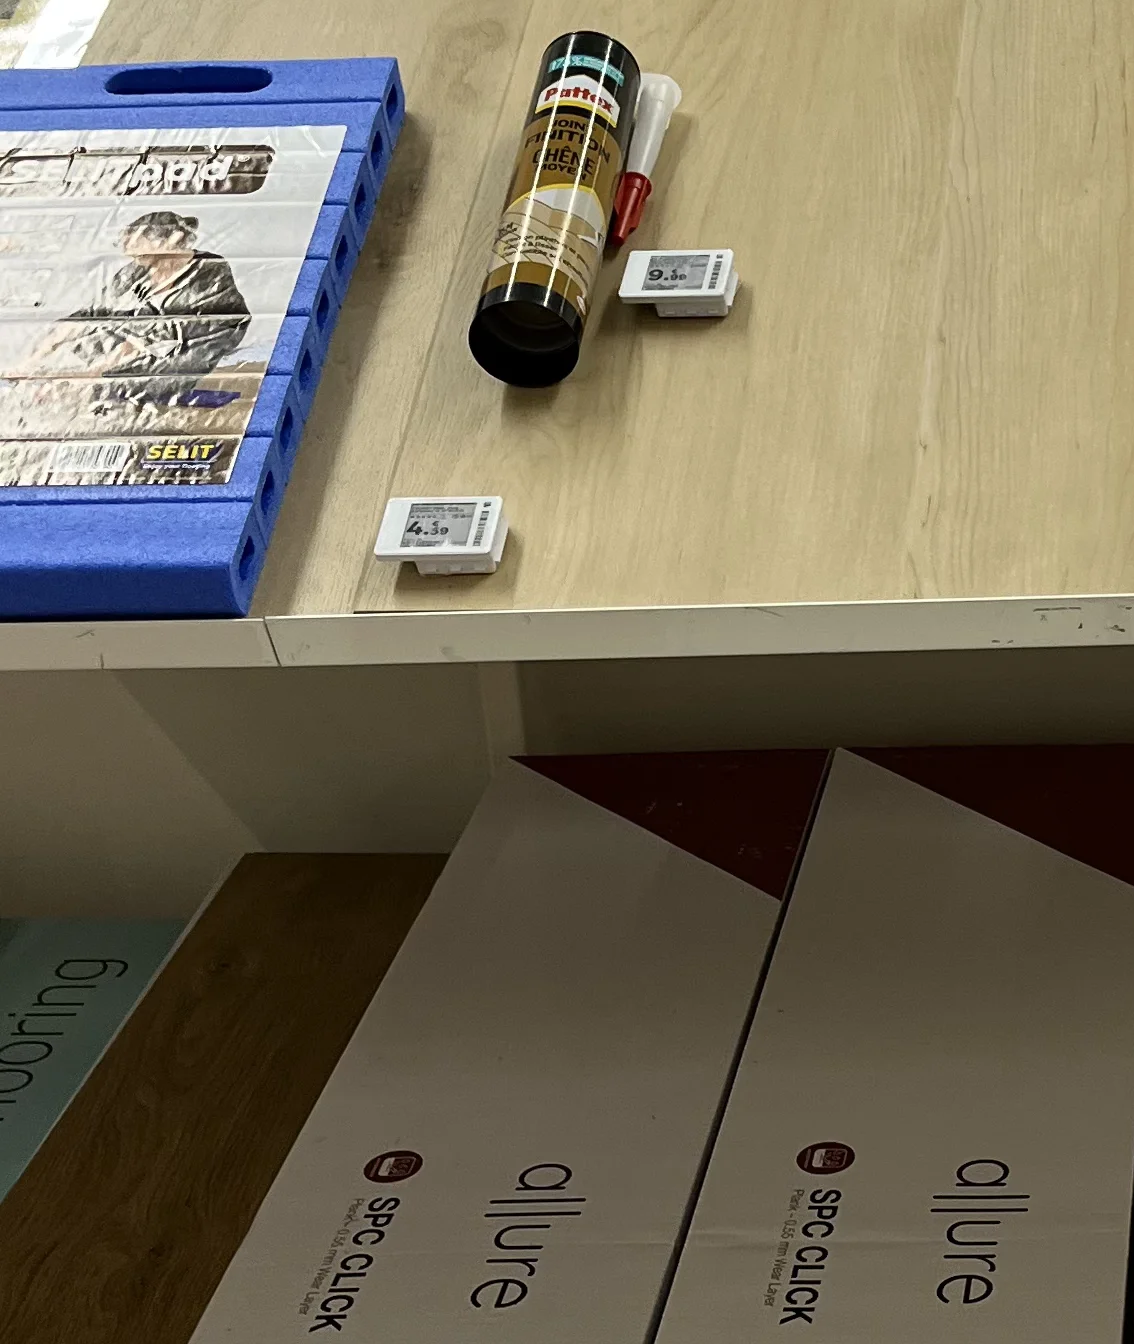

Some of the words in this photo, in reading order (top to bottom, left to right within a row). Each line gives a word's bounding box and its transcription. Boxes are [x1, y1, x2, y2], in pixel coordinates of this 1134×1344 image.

[544, 86, 614, 114] Pattex
[525, 130, 610, 164] FINITION
[552, 119, 594, 131] JOIN
[532, 146, 595, 176] CHÊNE
[147, 444, 215, 459] SELIT
[0, 958, 128, 1106] ooring
[352, 1197, 400, 1246] SPC
[471, 1163, 586, 1308] allure
[801, 1189, 842, 1238] SPC
[930, 1159, 1030, 1304] allure
[308, 1253, 374, 1333] CLICK
[779, 1246, 829, 1325] CLICK
